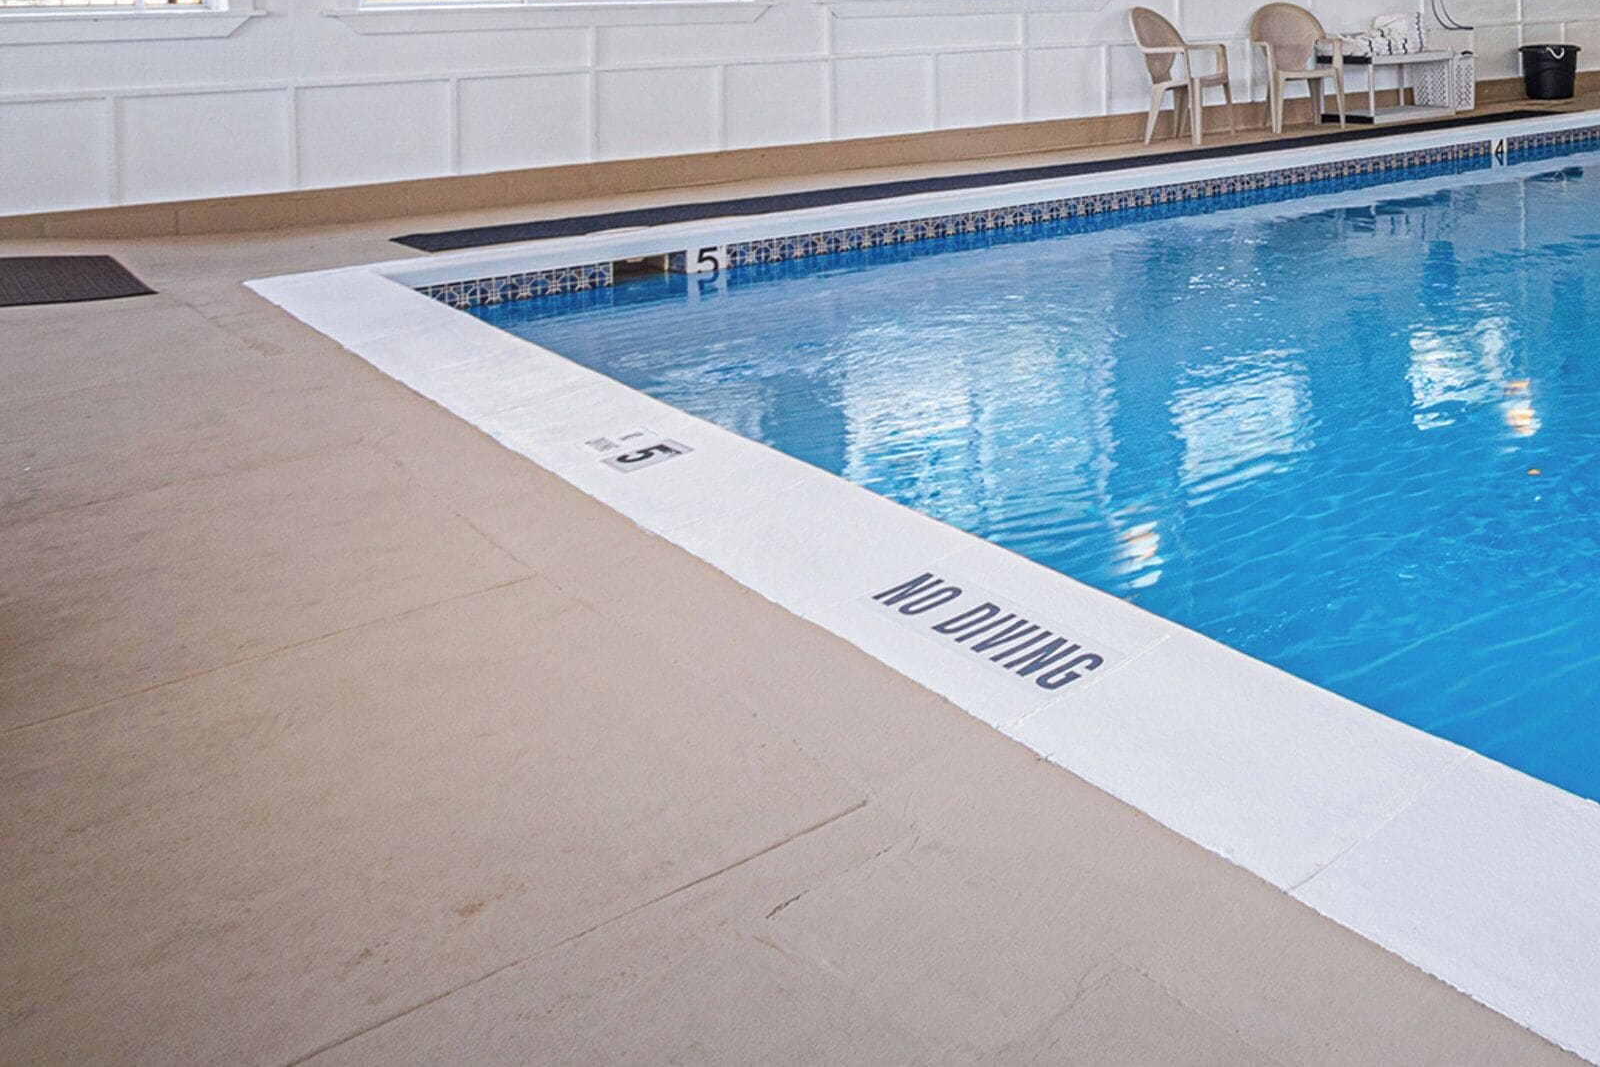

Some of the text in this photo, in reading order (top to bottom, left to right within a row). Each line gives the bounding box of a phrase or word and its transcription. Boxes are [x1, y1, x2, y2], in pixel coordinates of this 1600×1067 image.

[697, 246, 719, 273] 5
[616, 444, 678, 463] 5
[872, 572, 1104, 690] NO DIVING
